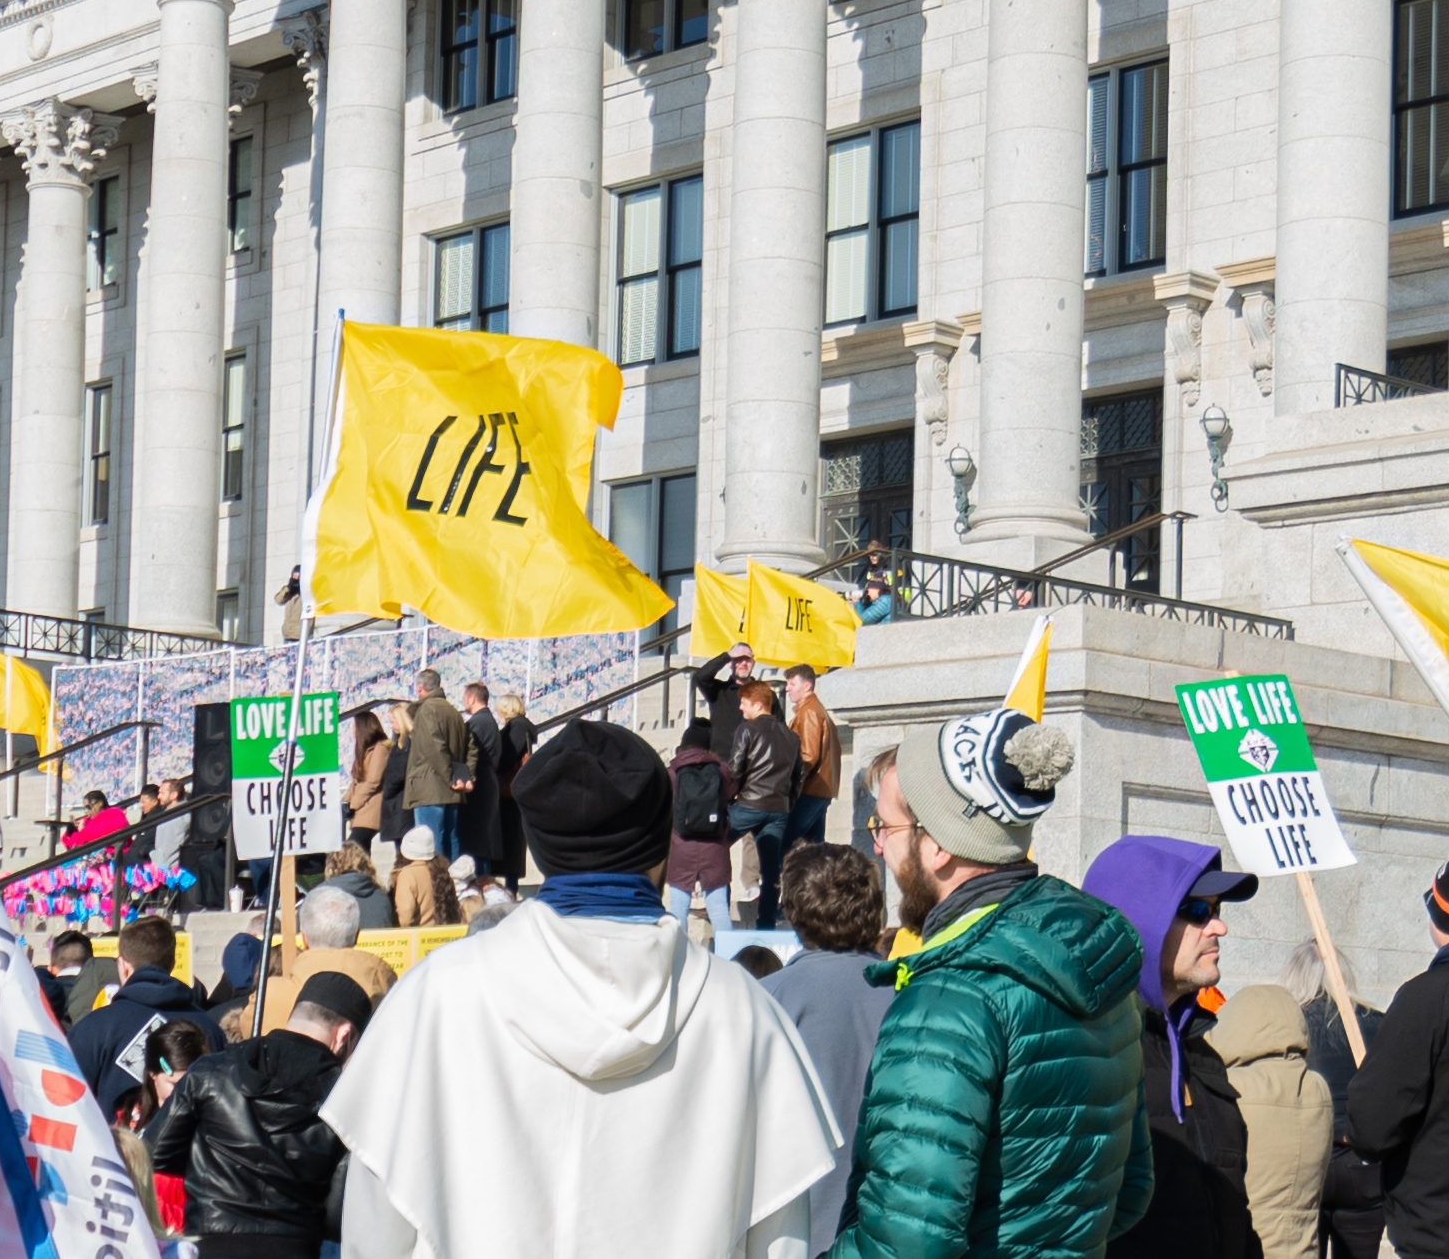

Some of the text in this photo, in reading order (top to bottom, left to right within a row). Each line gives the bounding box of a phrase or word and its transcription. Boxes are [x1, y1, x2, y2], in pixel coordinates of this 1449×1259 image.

[406, 411, 532, 527] LIFE
[785, 596, 813, 633] LIFE
[236, 702, 286, 740] LOVE
[1182, 681, 1297, 735] LOVE LIFE
[1227, 776, 1321, 826] CHOOSE
[269, 817, 307, 851] LFE
[1265, 824, 1317, 869] LIFE
